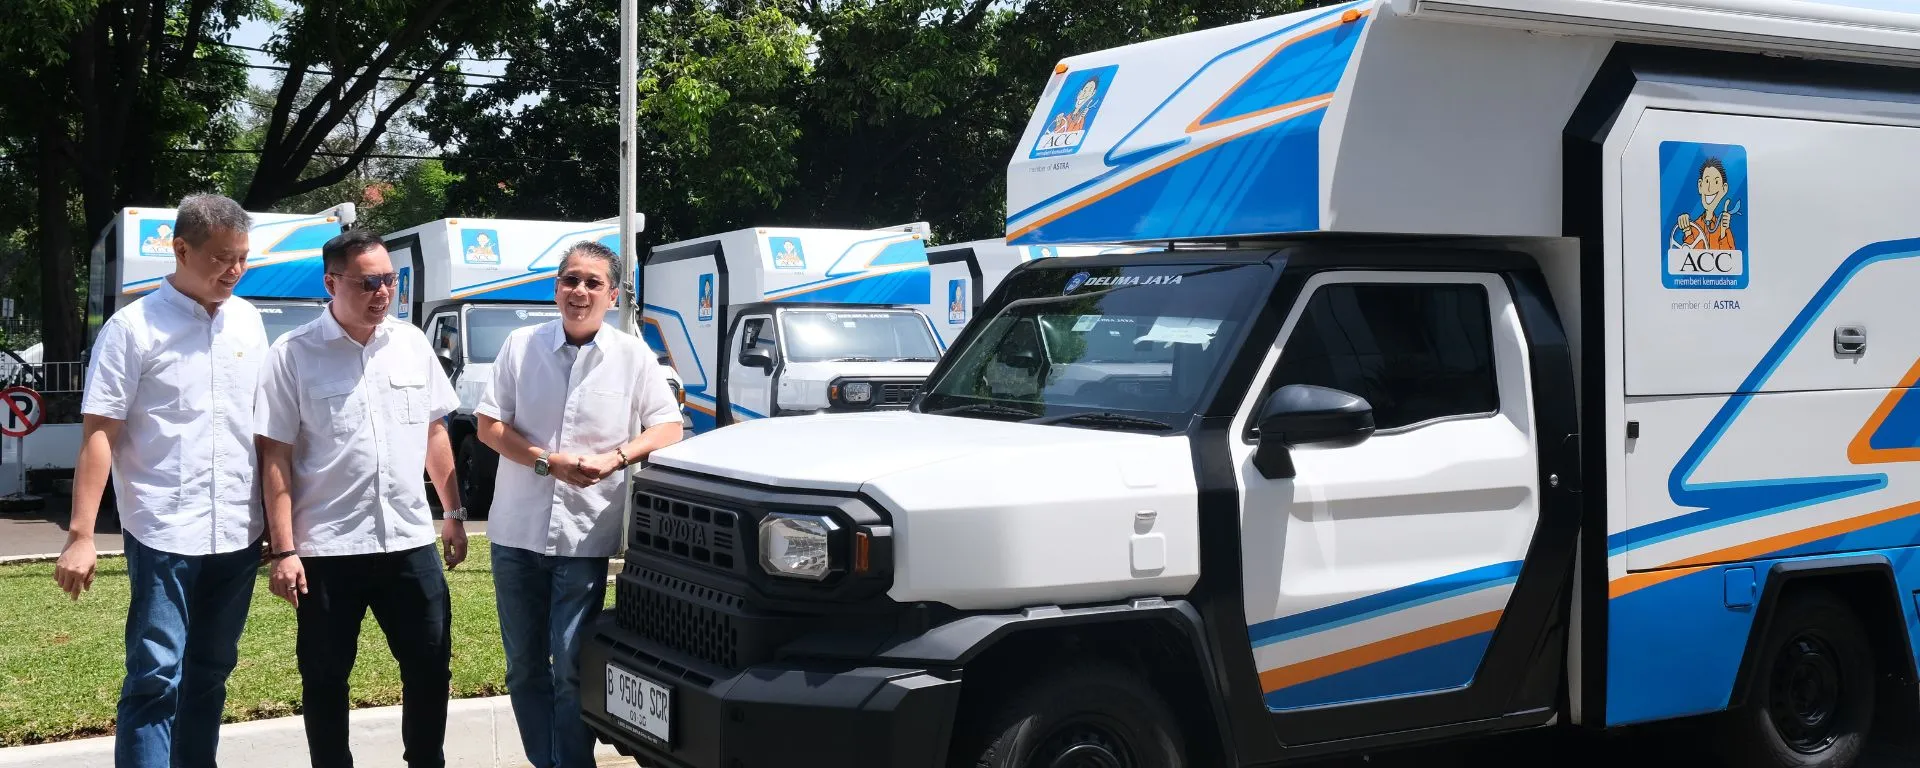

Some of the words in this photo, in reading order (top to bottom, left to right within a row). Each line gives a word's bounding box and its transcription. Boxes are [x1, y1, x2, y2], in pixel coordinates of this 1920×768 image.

[1042, 132, 1078, 149] ACC
[1053, 162, 1069, 171] ASTRA
[1680, 252, 1733, 272] ACC
[1084, 276, 1139, 286] DELIMA
[1140, 275, 1182, 285] JAYA
[1674, 277, 1701, 286] memberi
[1703, 277, 1738, 286] kemudahan
[1671, 301, 1700, 310] member
[1703, 301, 1711, 310] of
[1713, 300, 1741, 310] ASTRA
[656, 515, 706, 546] TOYOTA
[608, 668, 614, 696] B
[620, 674, 643, 710] 9506
[650, 687, 668, 724] SCR
